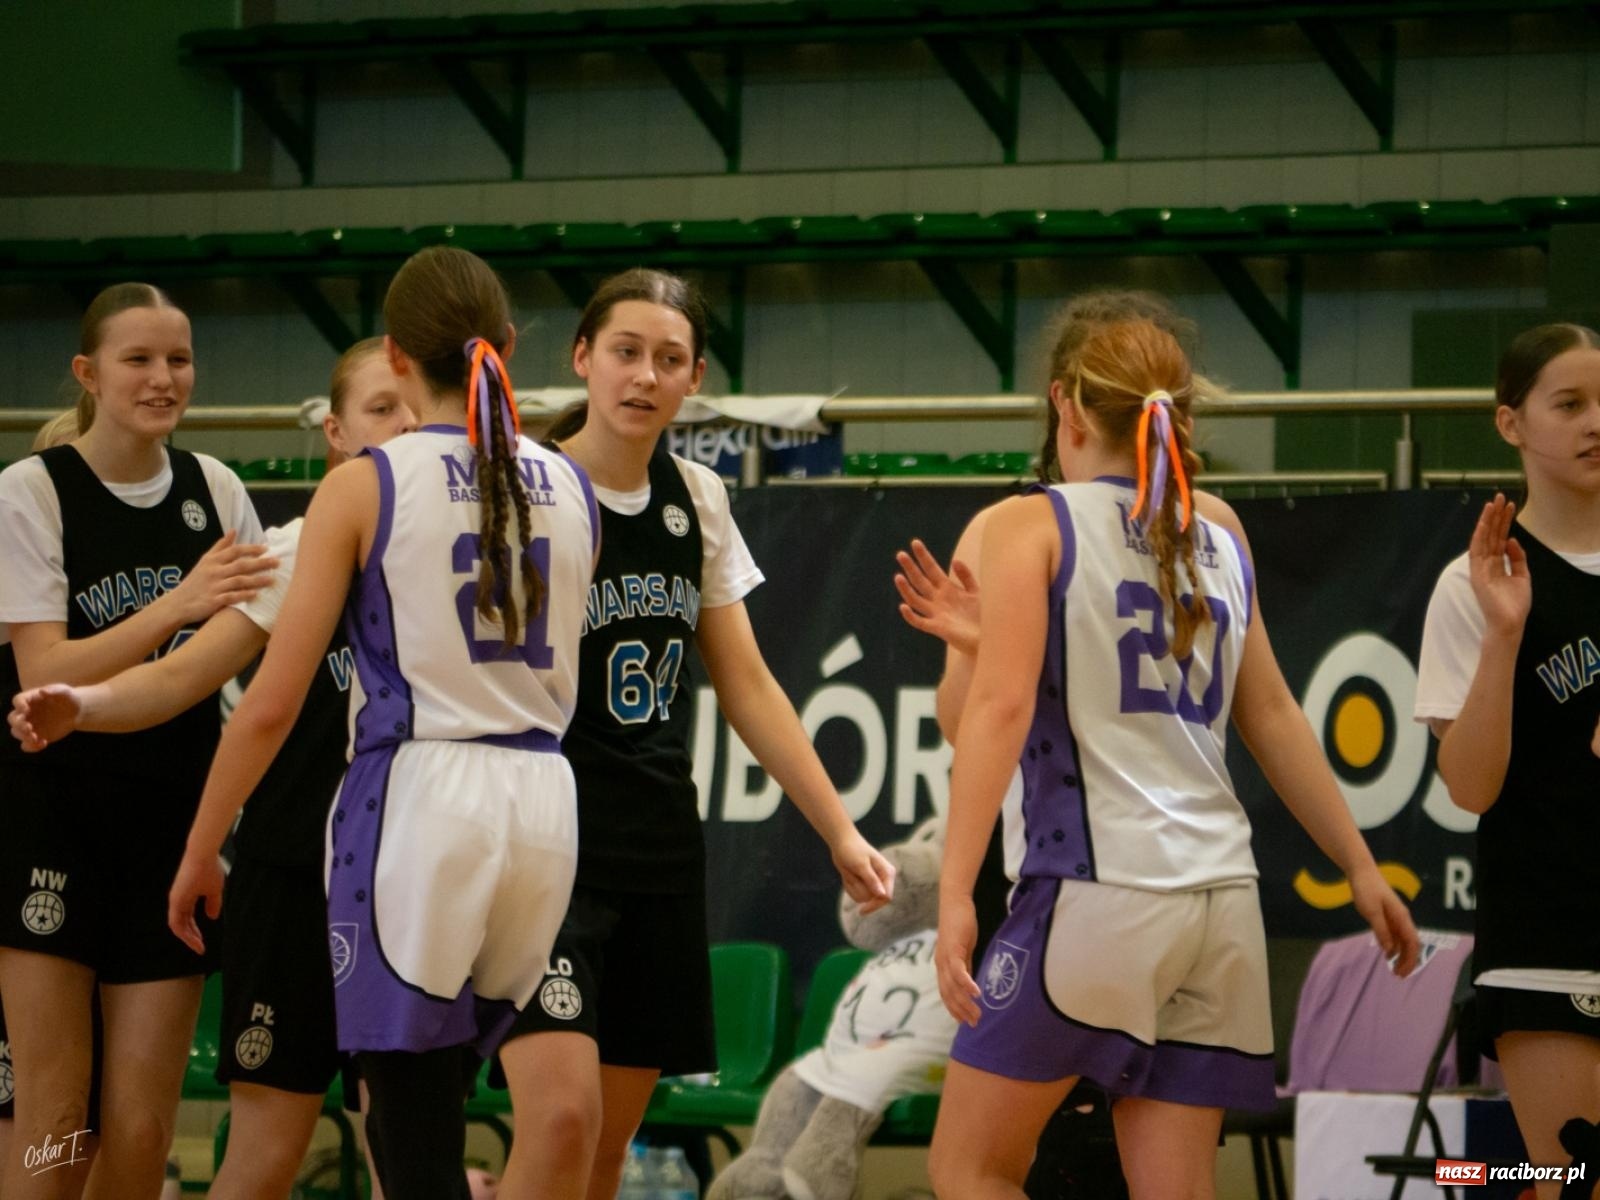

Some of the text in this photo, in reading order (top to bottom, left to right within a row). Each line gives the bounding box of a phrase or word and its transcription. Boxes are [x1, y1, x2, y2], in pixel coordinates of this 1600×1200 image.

[440, 454, 554, 491] MNI
[448, 488, 556, 506] BASALL
[76, 566, 182, 629] WARS
[452, 533, 554, 669] 21
[607, 639, 683, 725] 64
[1116, 580, 1230, 729] 20
[30, 867, 67, 891] NW
[843, 984, 920, 1044] 12
